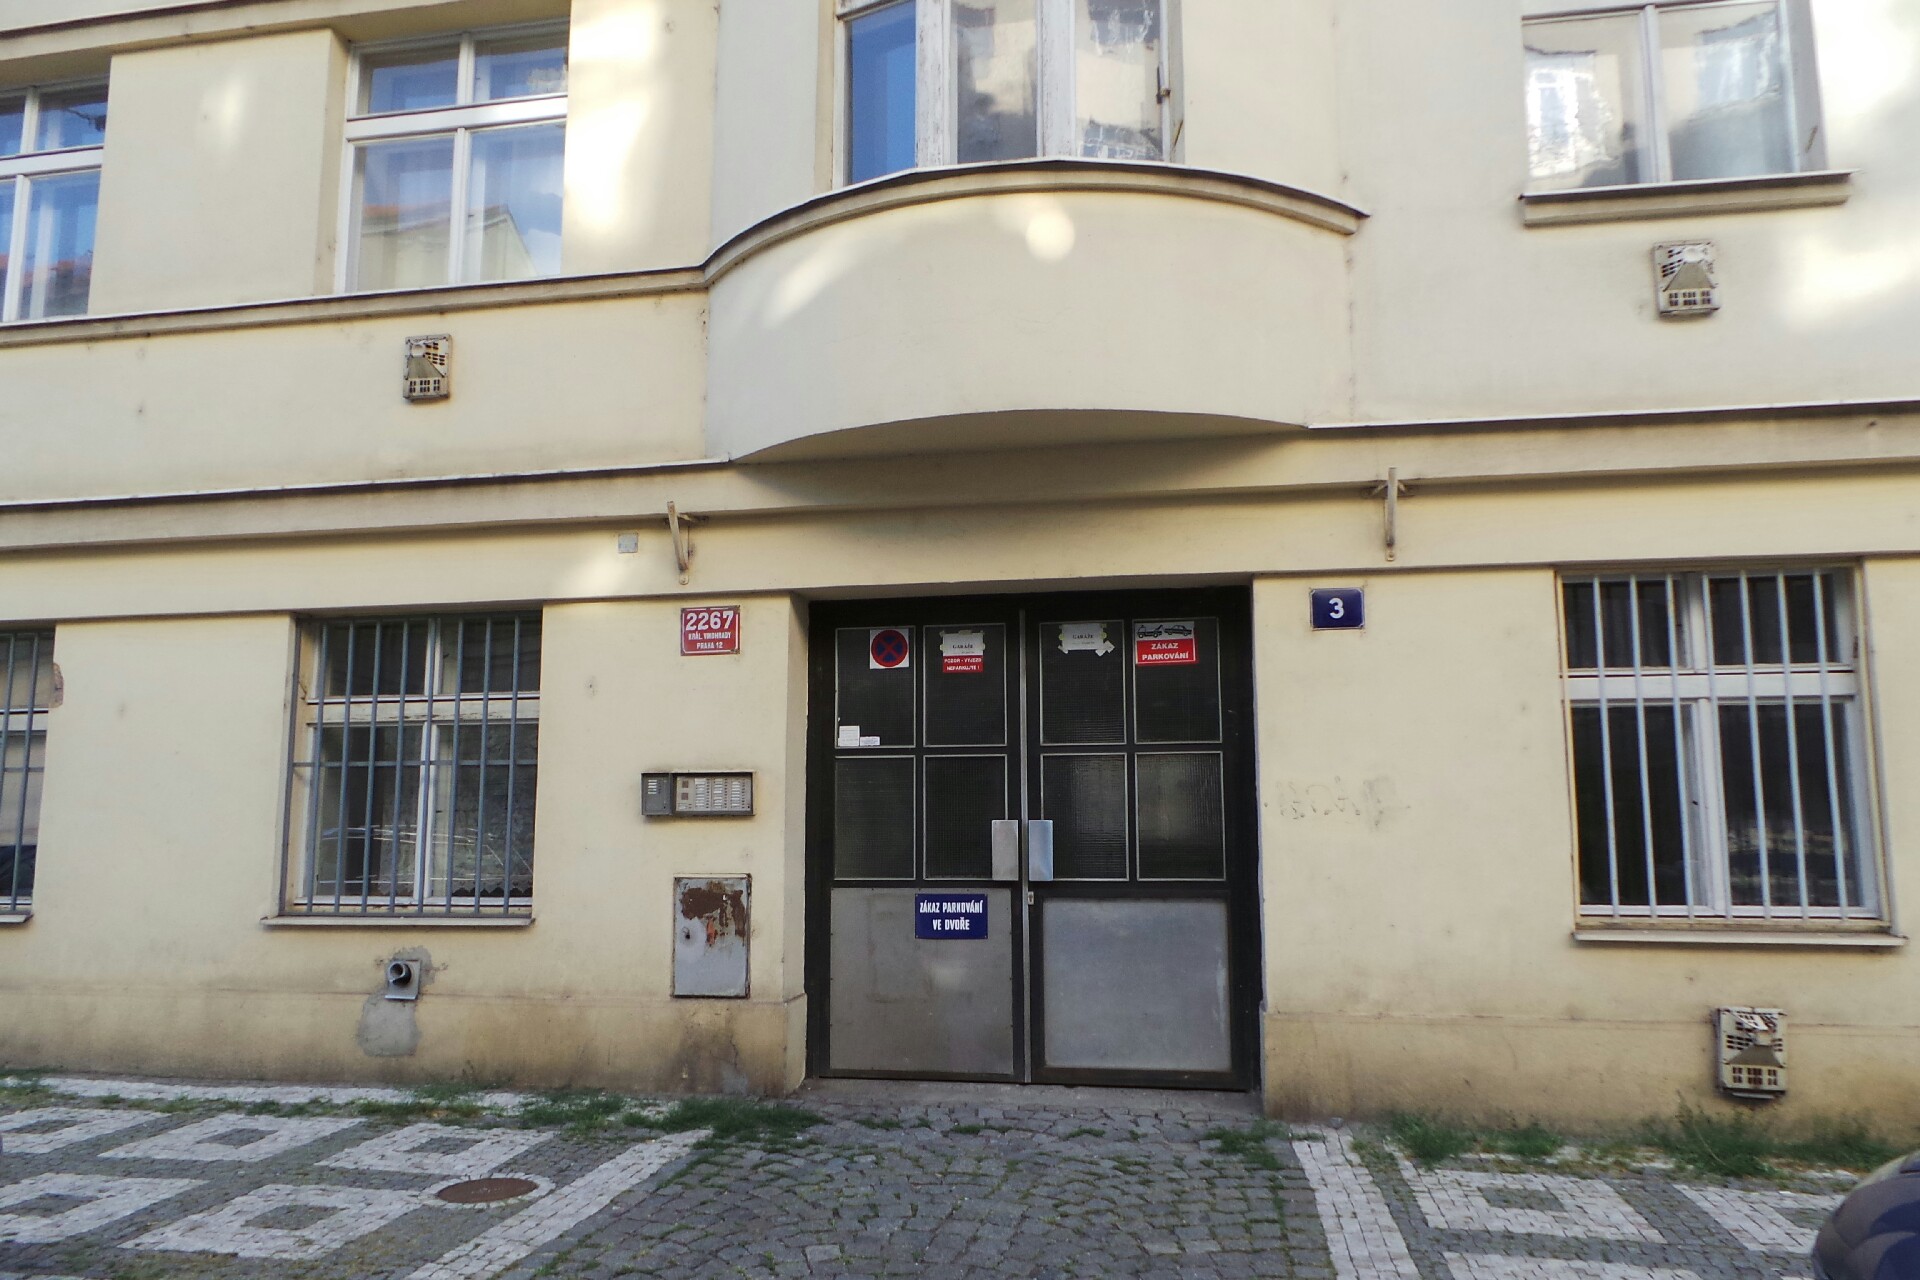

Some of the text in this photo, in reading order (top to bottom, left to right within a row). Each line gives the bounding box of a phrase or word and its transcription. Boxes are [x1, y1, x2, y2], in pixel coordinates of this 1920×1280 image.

[1329, 597, 1345, 619] 3
[685, 610, 733, 630] 2267
[696, 641, 723, 650] PRAHA 12
[1151, 642, 1179, 650] ZÁKAZ
[1141, 651, 1190, 661] PARKOVÁNÍ
[919, 899, 984, 914] ZÁKAZ PARKOVÁNÍ
[932, 916, 970, 931] VE DVOŘE
